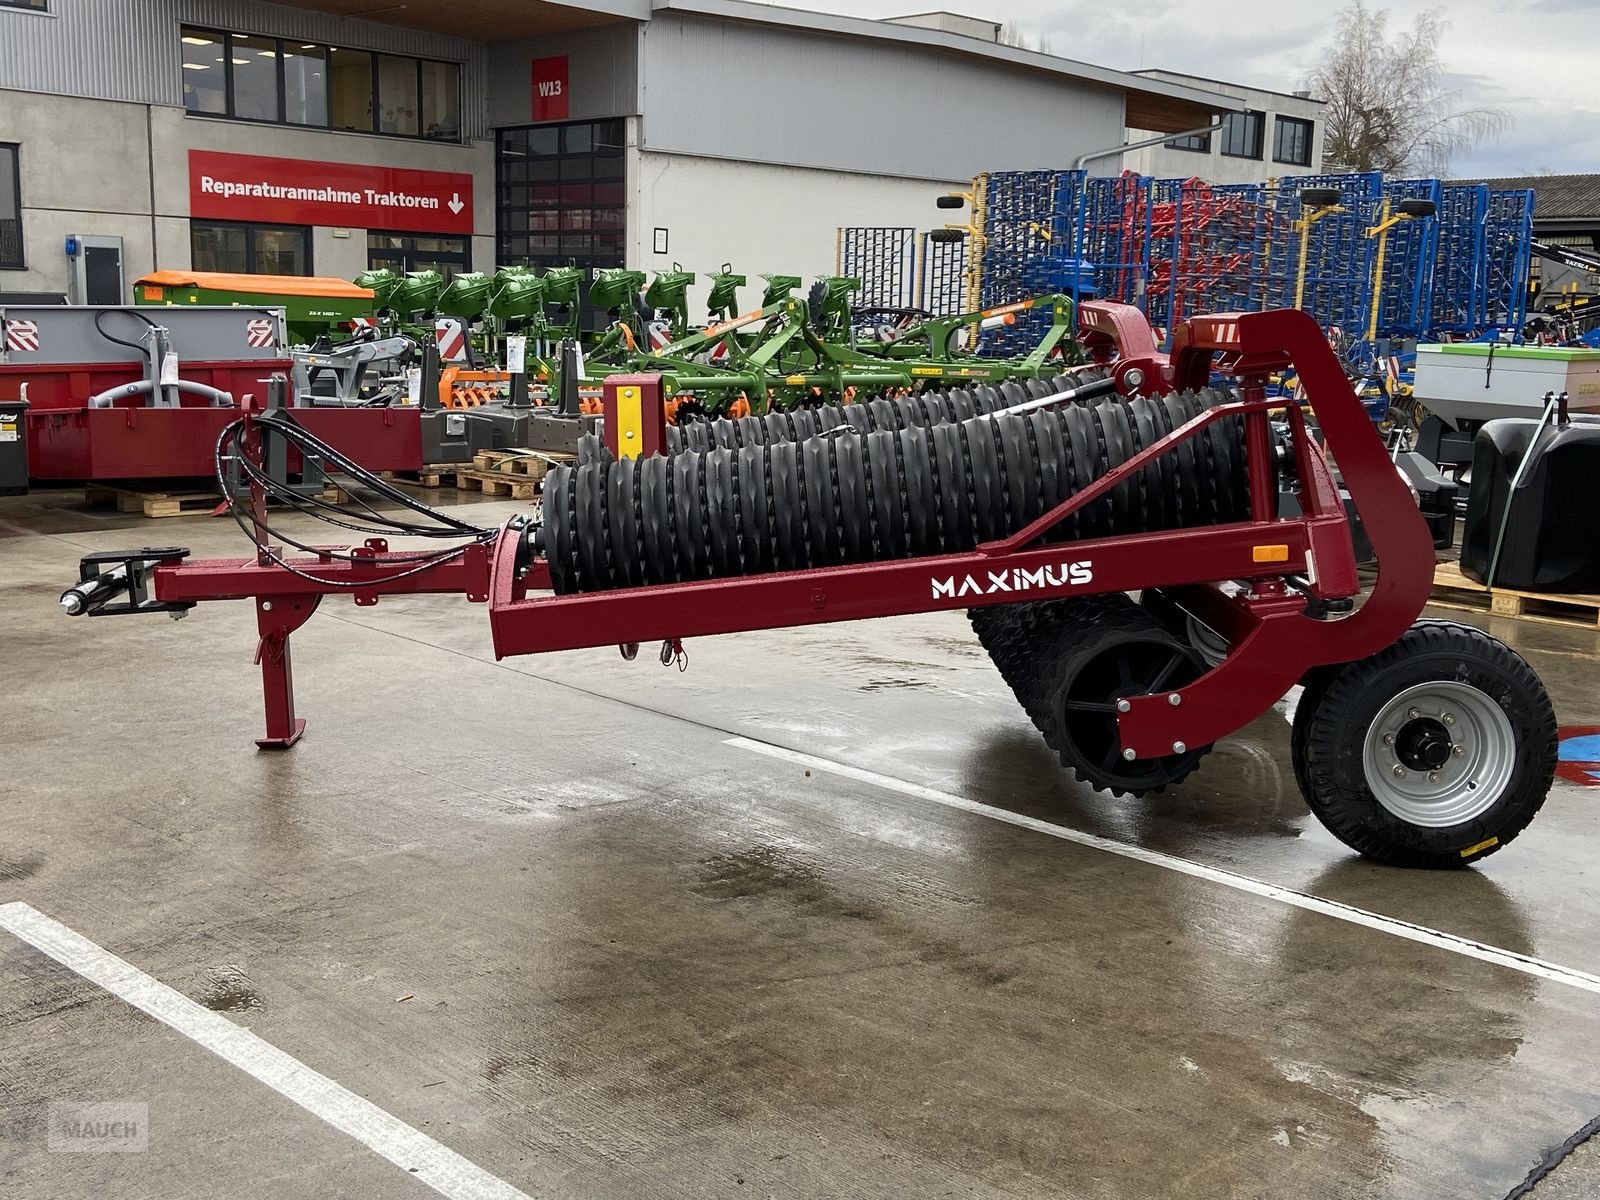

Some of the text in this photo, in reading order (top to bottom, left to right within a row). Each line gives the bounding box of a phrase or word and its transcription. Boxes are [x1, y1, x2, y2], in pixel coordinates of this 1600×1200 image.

[538, 80, 562, 97] W13
[201, 176, 439, 209] Reparaturannahme Traktoren
[931, 560, 1093, 599] MAXIMUS
